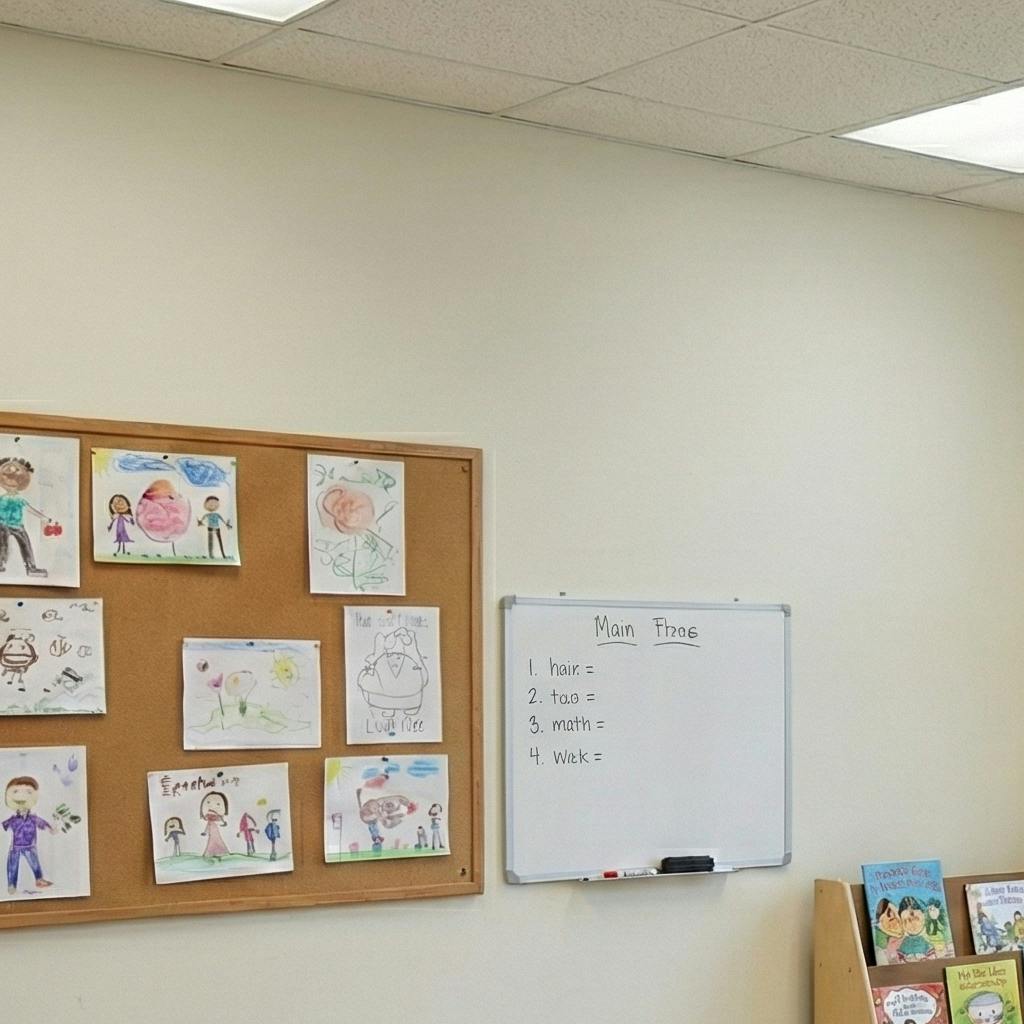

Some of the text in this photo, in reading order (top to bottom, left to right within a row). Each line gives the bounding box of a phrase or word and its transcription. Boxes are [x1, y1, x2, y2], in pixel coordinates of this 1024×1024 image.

[594, 615, 635, 638] Main
[529, 658, 538, 677] 1.
[528, 687, 543, 705] 2.
[529, 715, 544, 734] 3.
[552, 715, 591, 732] math
[529, 746, 544, 766] 4.
